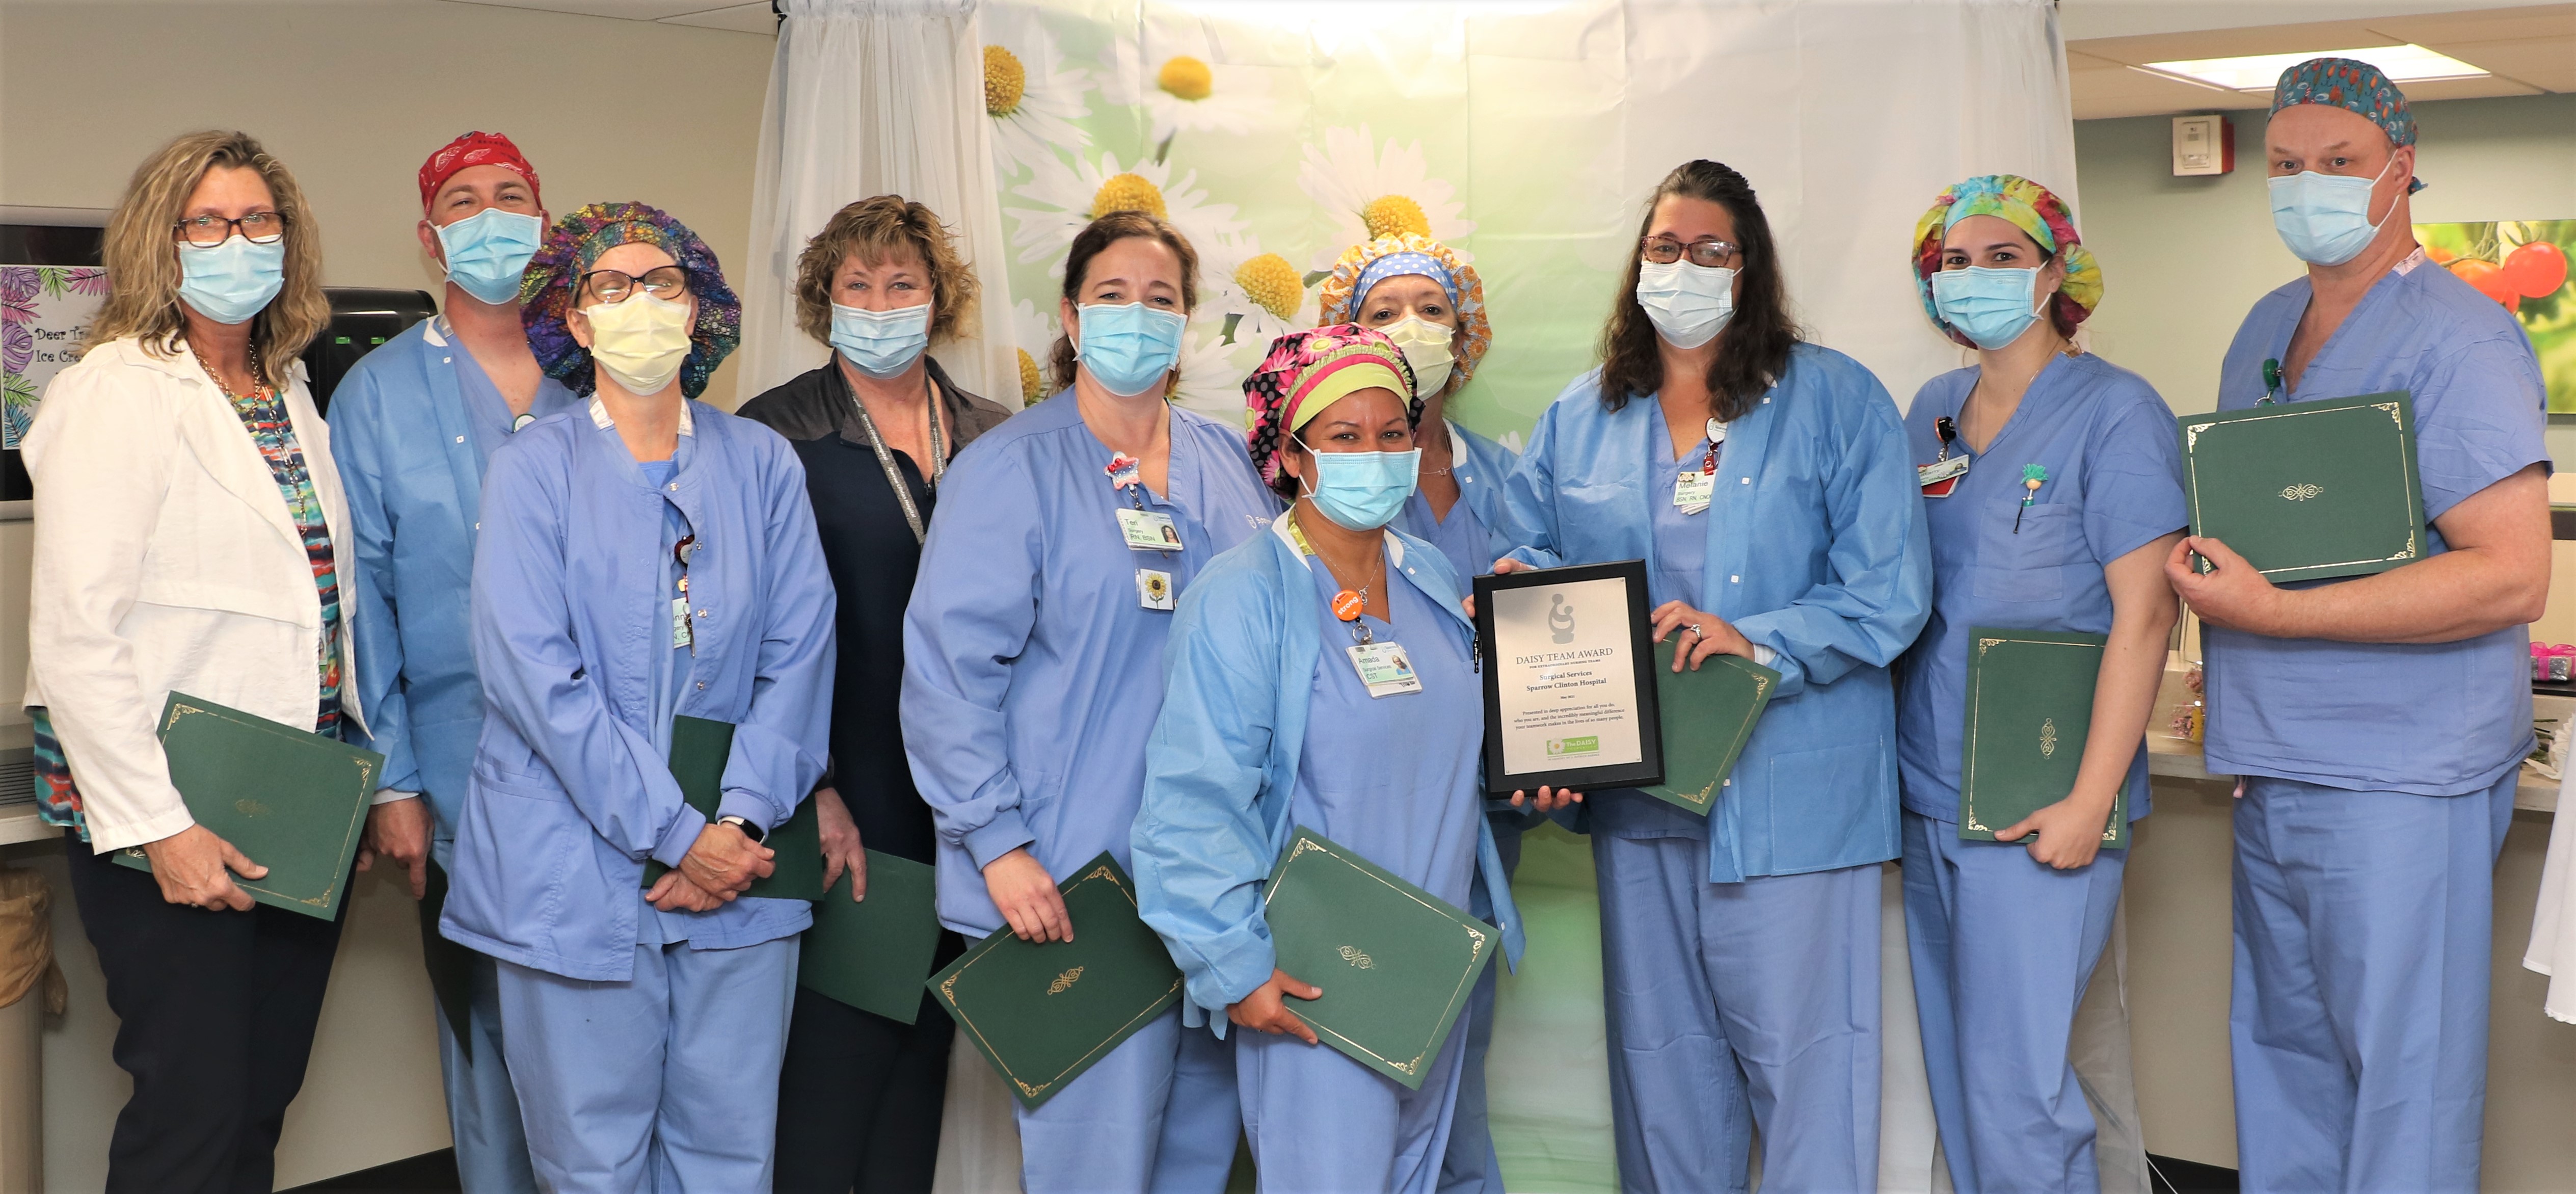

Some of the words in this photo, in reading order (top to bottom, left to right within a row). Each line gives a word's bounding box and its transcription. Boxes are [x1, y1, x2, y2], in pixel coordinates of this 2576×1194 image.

[35, 328, 66, 340] Deer
[70, 326, 89, 340] Tr
[36, 350, 55, 362] Ice
[59, 350, 84, 362] Cre
[897, 484, 907, 499] Clinton
[904, 499, 917, 518] Hospital
[1338, 596, 1359, 615] strong
[1358, 656, 1380, 664] Amada
[1516, 654, 1545, 665] DAISY
[1546, 651, 1575, 661] TEAM
[1577, 648, 1613, 658] AWARD
[1540, 672, 1565, 681] Surgical
[1526, 684, 1553, 693] Sparrow
[1579, 678, 1606, 686] Hospital
